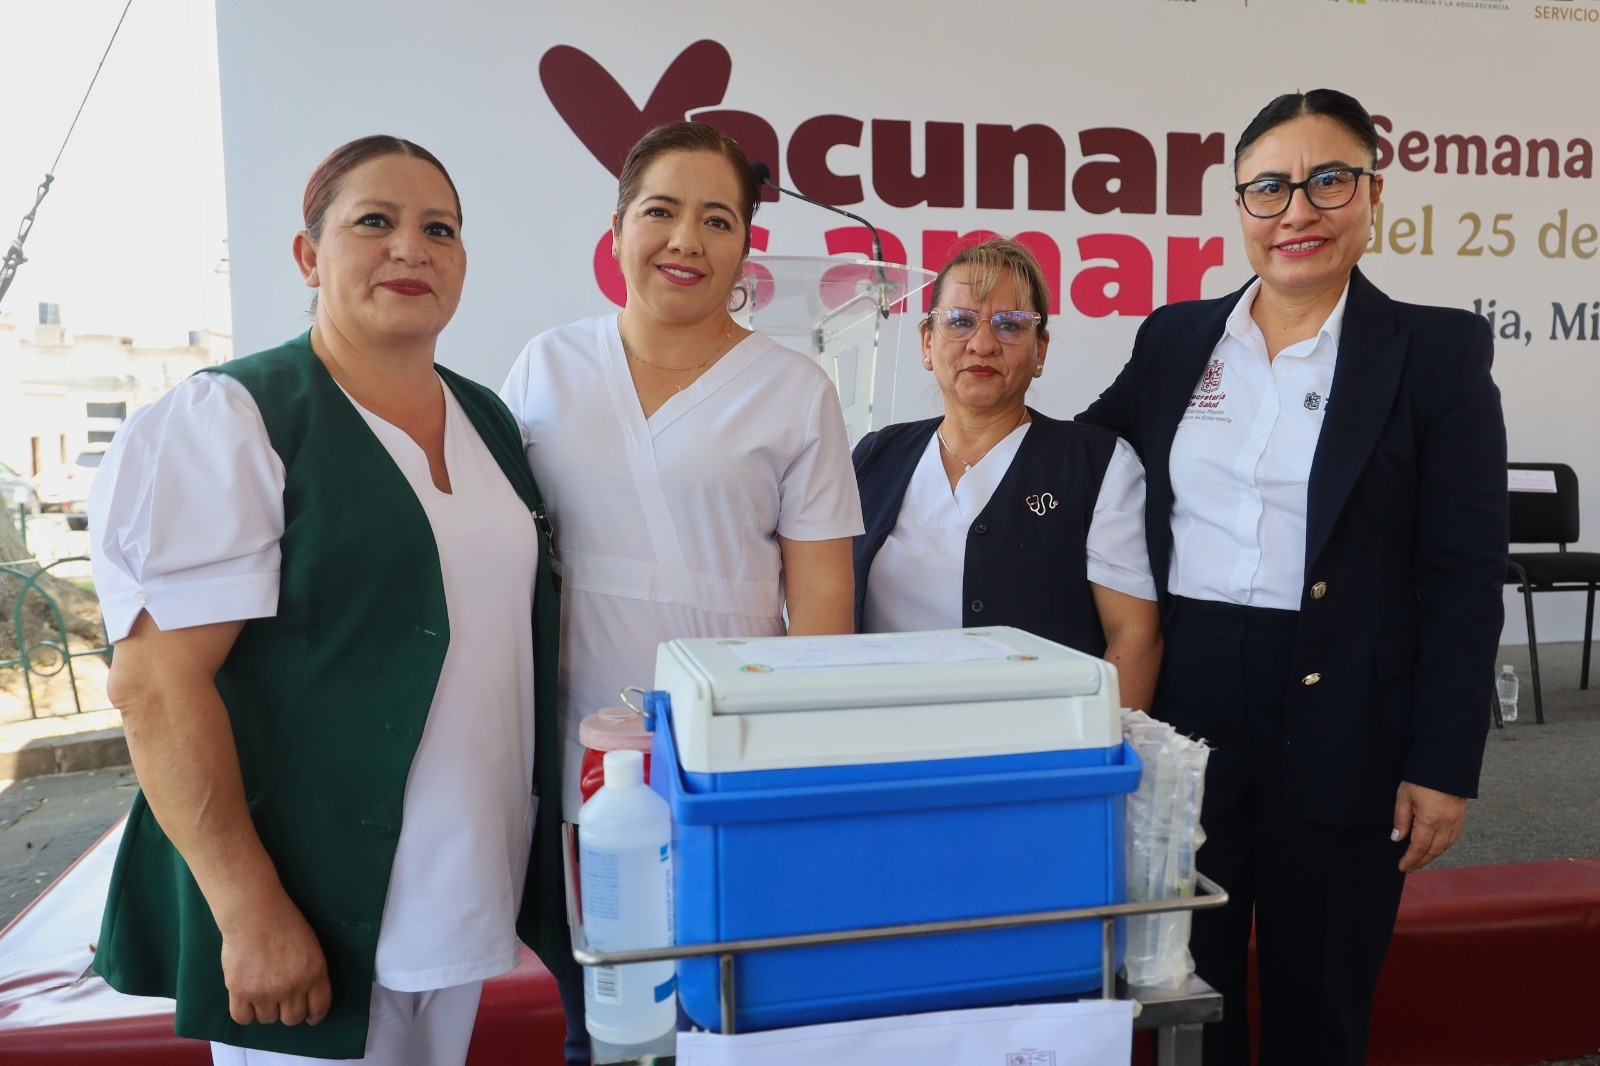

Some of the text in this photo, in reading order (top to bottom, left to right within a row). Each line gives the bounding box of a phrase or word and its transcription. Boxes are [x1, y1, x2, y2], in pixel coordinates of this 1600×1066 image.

[1456, 1, 1509, 11] ADOLESCENCIA
[1368, 114, 1594, 180] Semana
[1456, 212, 1517, 258] 25
[1538, 208, 1599, 260] de
[1198, 400, 1220, 408] Salud
